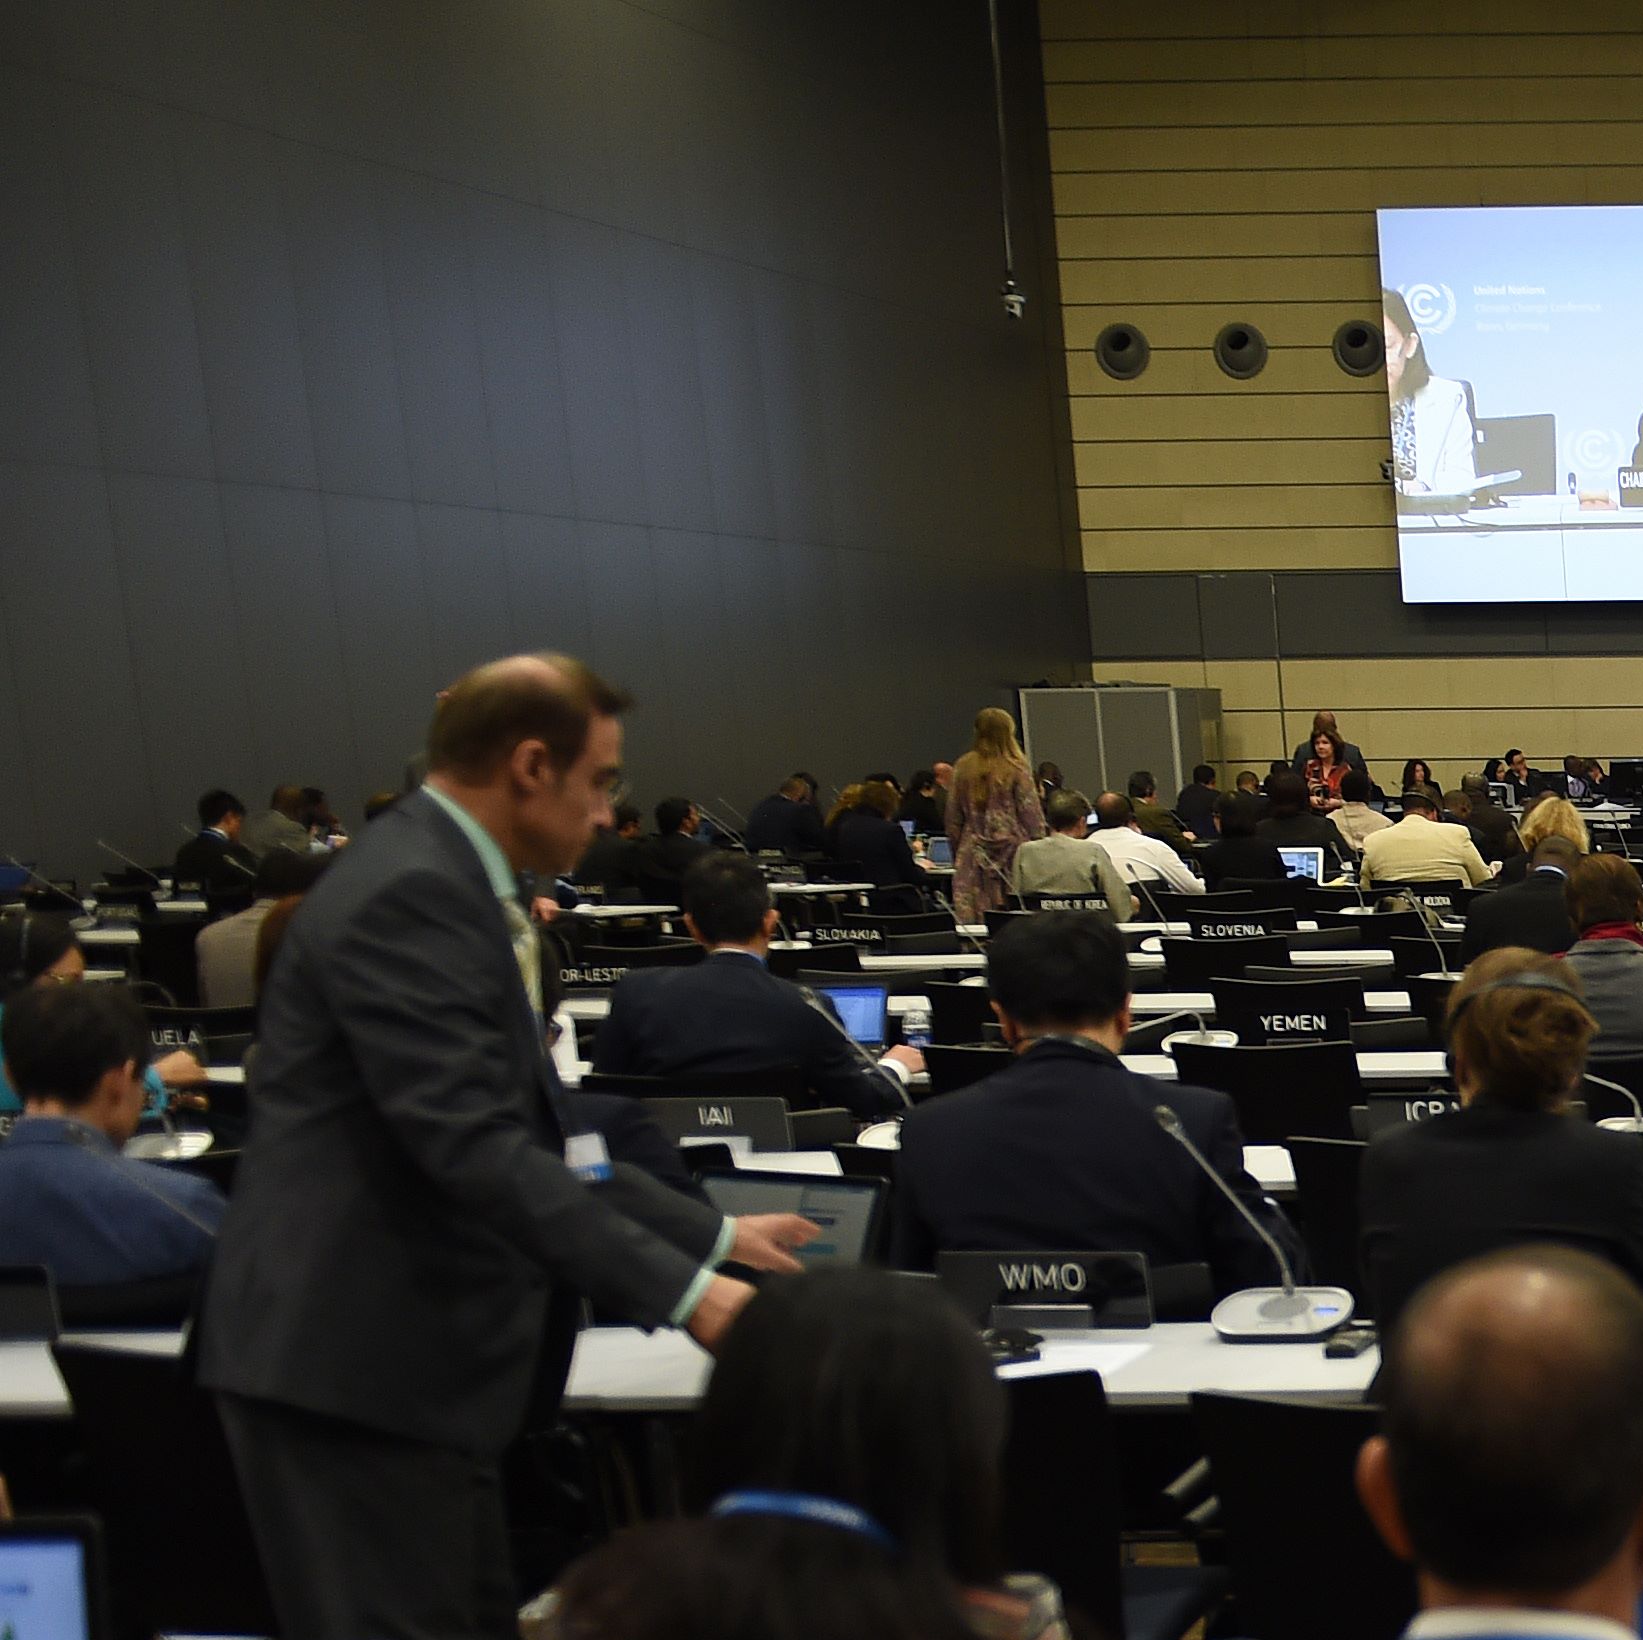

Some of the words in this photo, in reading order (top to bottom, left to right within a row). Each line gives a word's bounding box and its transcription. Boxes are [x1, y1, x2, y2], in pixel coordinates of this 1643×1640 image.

[816, 928, 882, 941] SLOVAKIA
[1202, 925, 1266, 936] SLOVENIA
[1260, 1015, 1327, 1032] YEMEN
[698, 1106, 734, 1126] IAI
[998, 1263, 1087, 1293] WMO
